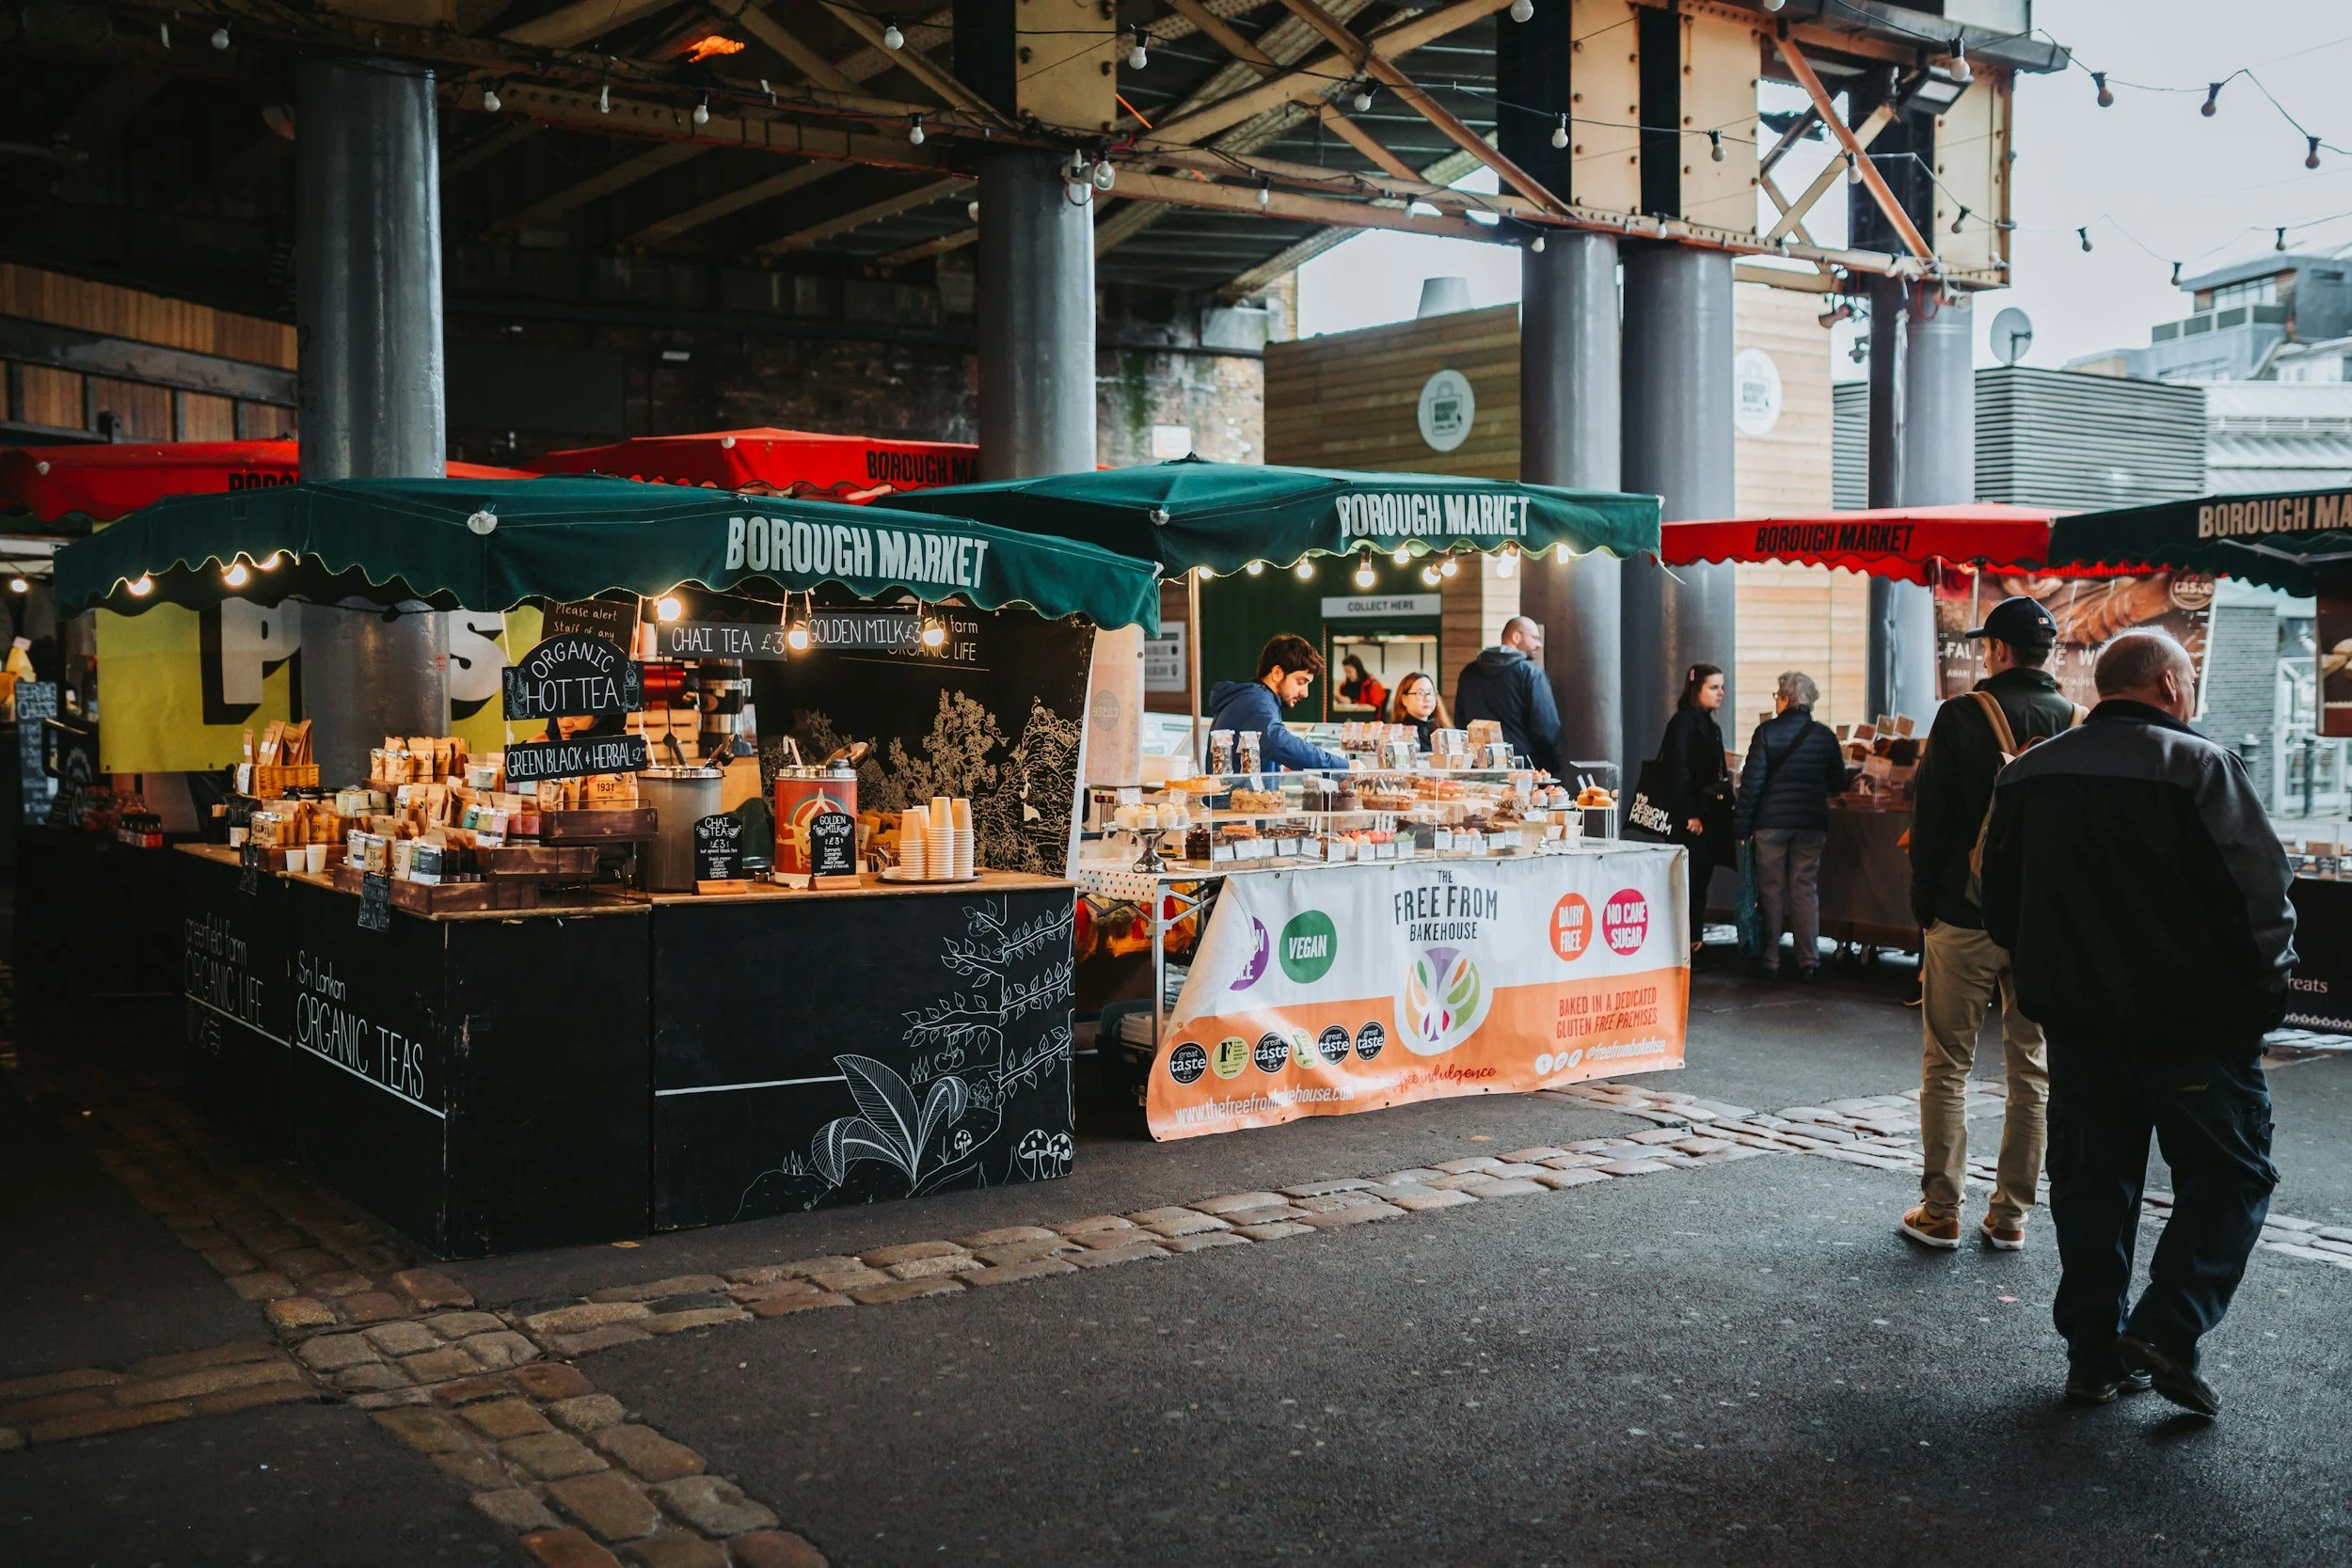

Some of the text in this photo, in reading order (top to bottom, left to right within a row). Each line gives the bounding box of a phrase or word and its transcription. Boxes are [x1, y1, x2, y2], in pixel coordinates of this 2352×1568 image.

[867, 451, 947, 483] BOROUGH
[1336, 493, 1530, 538] BOROUGH MARKET
[2199, 498, 2310, 538] BOROUGH
[1755, 524, 1914, 553] BOROUGH MARKET
[725, 516, 988, 588] BOROUGH MARKET
[556, 603, 617, 621] Please alert
[1347, 600, 1414, 612] COLLECT HERE
[808, 619, 862, 643] GOLDEN
[865, 619, 905, 643] MILK
[904, 621, 922, 643] £3
[950, 614, 978, 633] farm
[598, 629, 614, 641] any
[672, 627, 785, 655] CHAI TEA £3
[531, 641, 614, 679] ORGANIC
[954, 641, 977, 660] LIFE
[526, 676, 620, 713] HOT TEA
[593, 742, 634, 768] HERBAL
[597, 783, 614, 792] 1931
[705, 817, 729, 828] CHAI
[819, 816, 846, 825] GOLDEN
[1632, 802, 1669, 821] DESIGN
[710, 827, 727, 836] TEA
[826, 824, 840, 833] MILK
[1629, 812, 1672, 835] MUSEUM
[1438, 870, 1453, 883] THE
[1394, 886, 1497, 925] FREE FROM
[1559, 904, 1584, 927] DAIRY
[1607, 901, 1646, 925] NO CANE
[226, 919, 247, 967] farm
[1410, 922, 1477, 942] BAKEHOUSE
[1561, 929, 1582, 953] FREE
[1611, 927, 1643, 950] SUGAR
[1289, 934, 1327, 959] VEGAN
[298, 950, 346, 1003] Sri Lankan
[2288, 976, 2328, 994] reats
[184, 951, 263, 1028] ORGANIC LIFE
[1559, 987, 1657, 1017] BAKED IN A DEDICATED
[1363, 1028, 1378, 1038] great
[1557, 1007, 1658, 1038] GLUTEN FREE PREMISES
[296, 992, 369, 1074] ORGANIC
[376, 1025, 424, 1101] TEAS
[1263, 1037, 1282, 1050] great
[1319, 1040, 1349, 1053] taste
[1326, 1032, 1343, 1043] great
[1358, 1036, 1384, 1050] taste
[1170, 1057, 1206, 1072] taste
[1178, 1050, 1198, 1060] great
[1255, 1046, 1289, 1061] taste
[1421, 1064, 1497, 1085] indulgence
